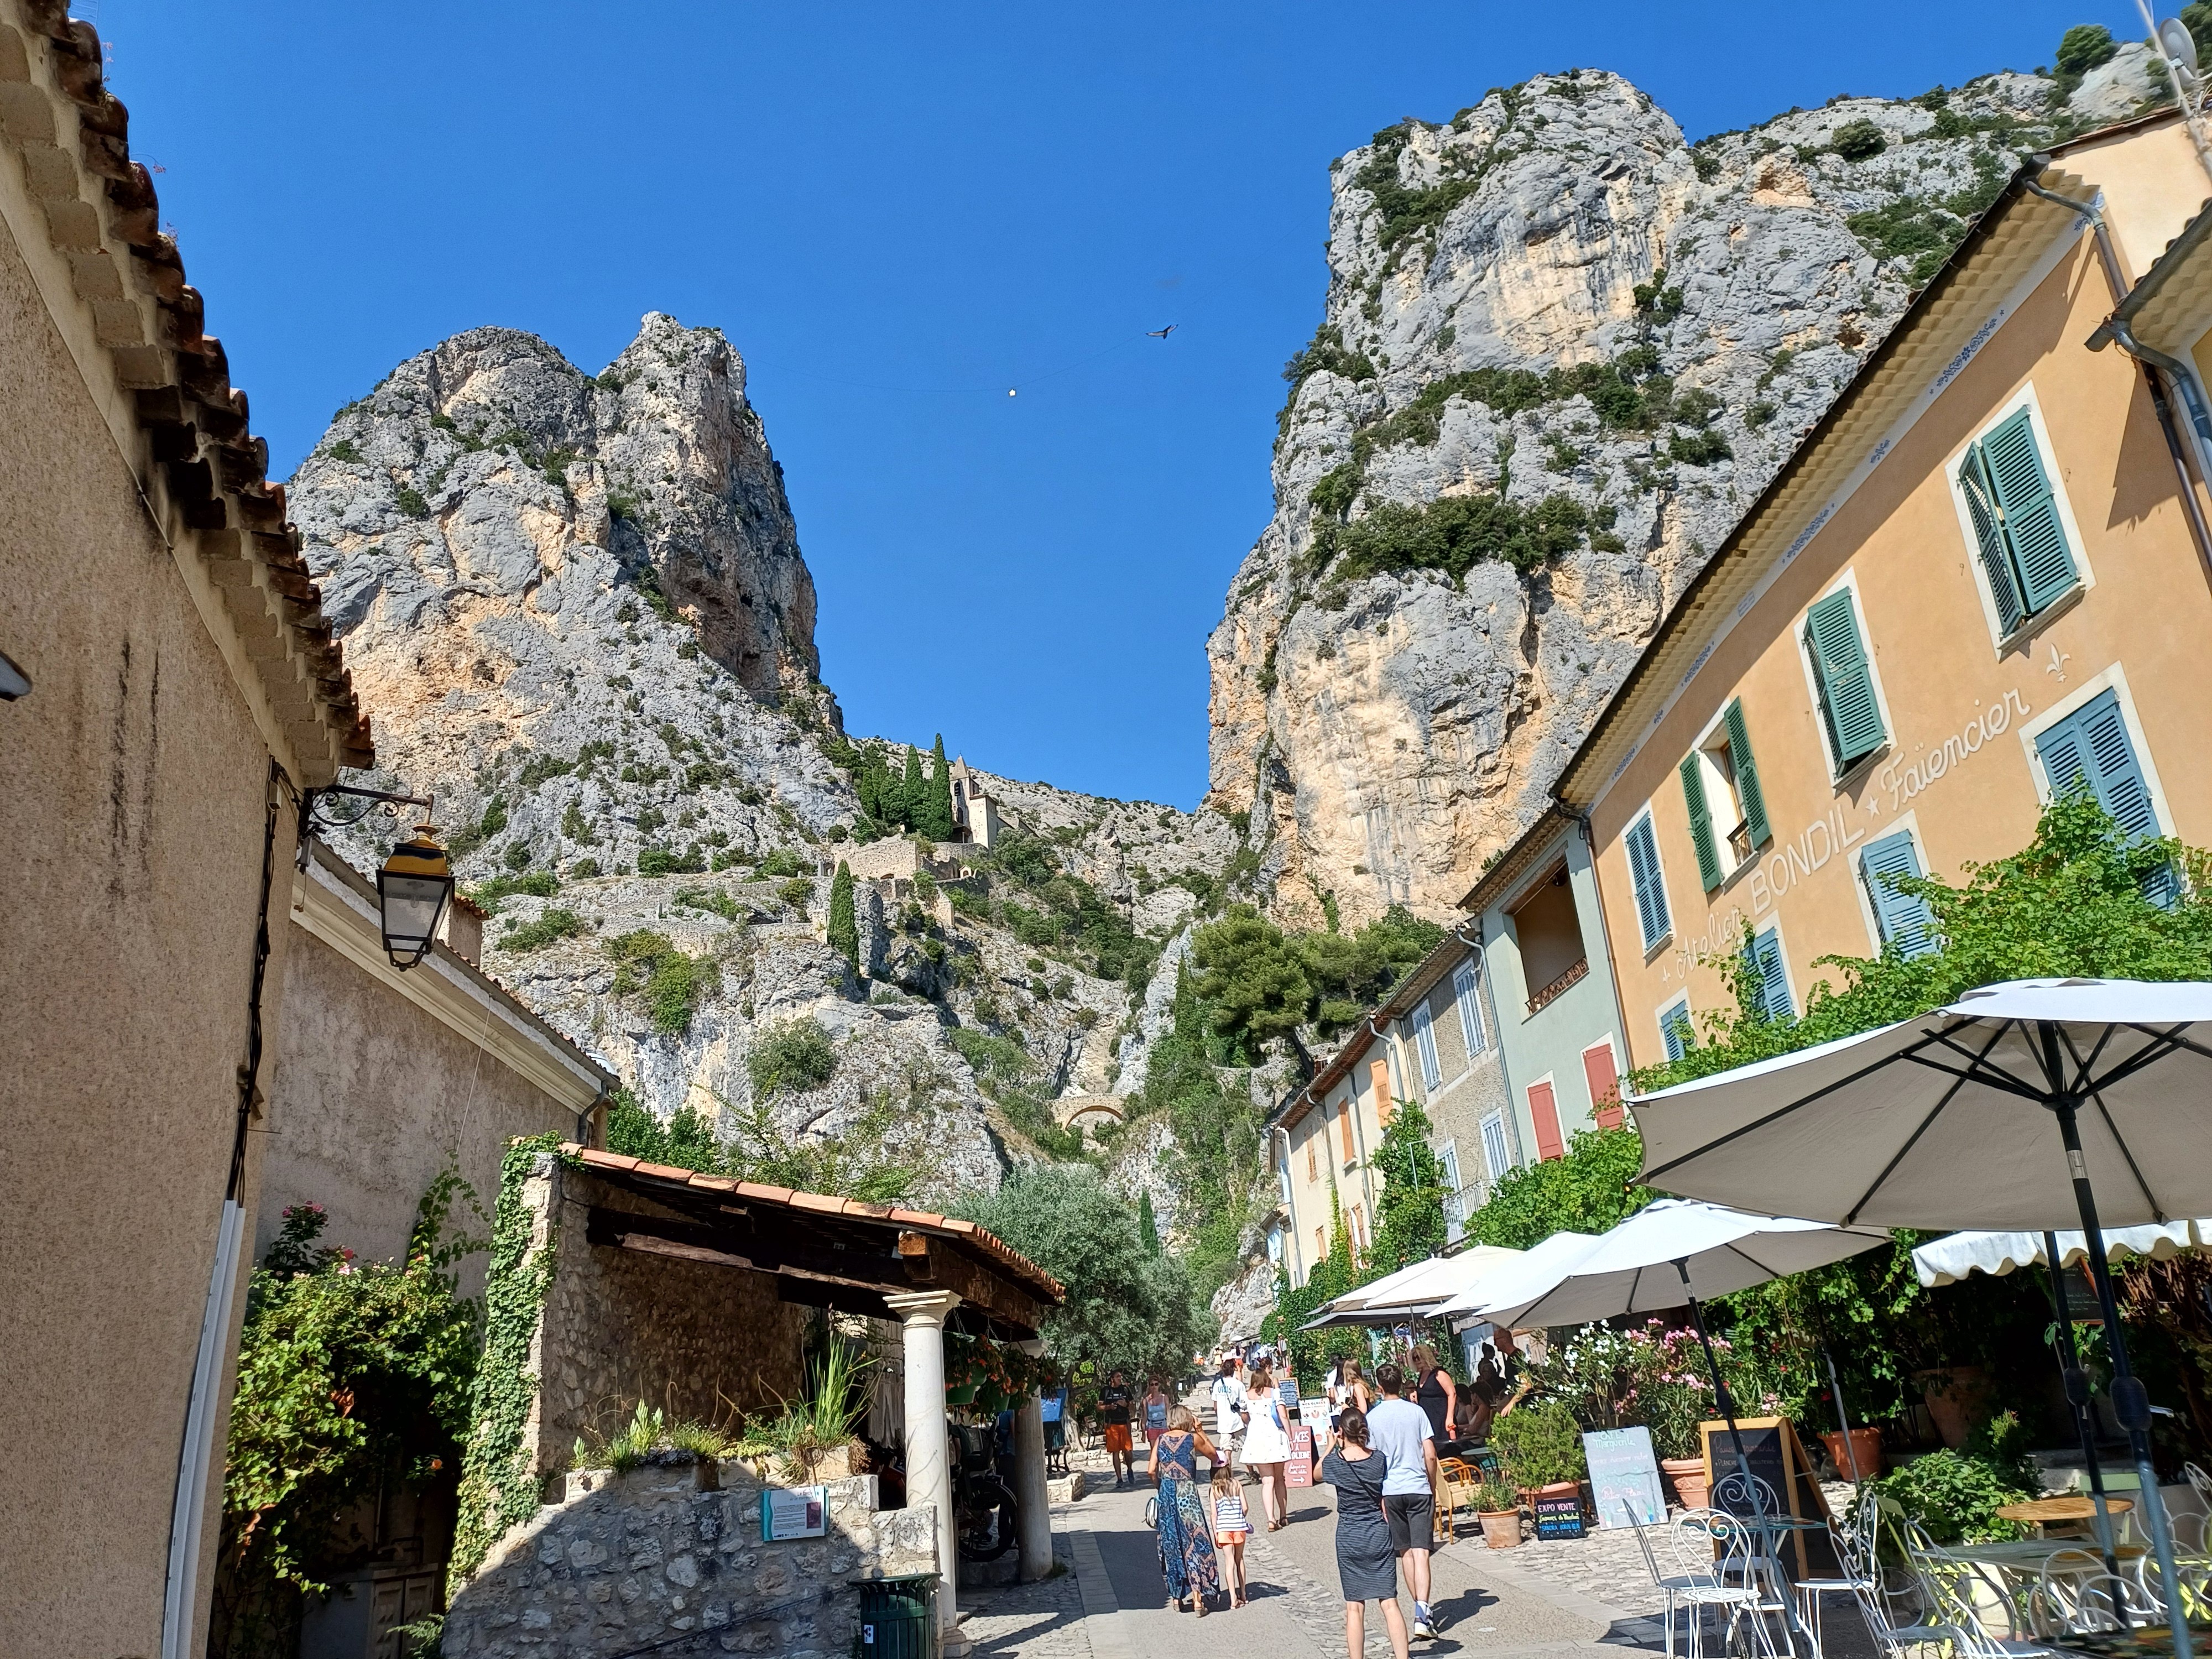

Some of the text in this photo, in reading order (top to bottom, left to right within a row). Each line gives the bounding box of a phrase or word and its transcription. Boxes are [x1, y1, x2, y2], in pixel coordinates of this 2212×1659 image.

[1677, 687, 2031, 980] Atelier BONDIL Faïencier
[1537, 1503, 1576, 1513] EXPO VENTE
